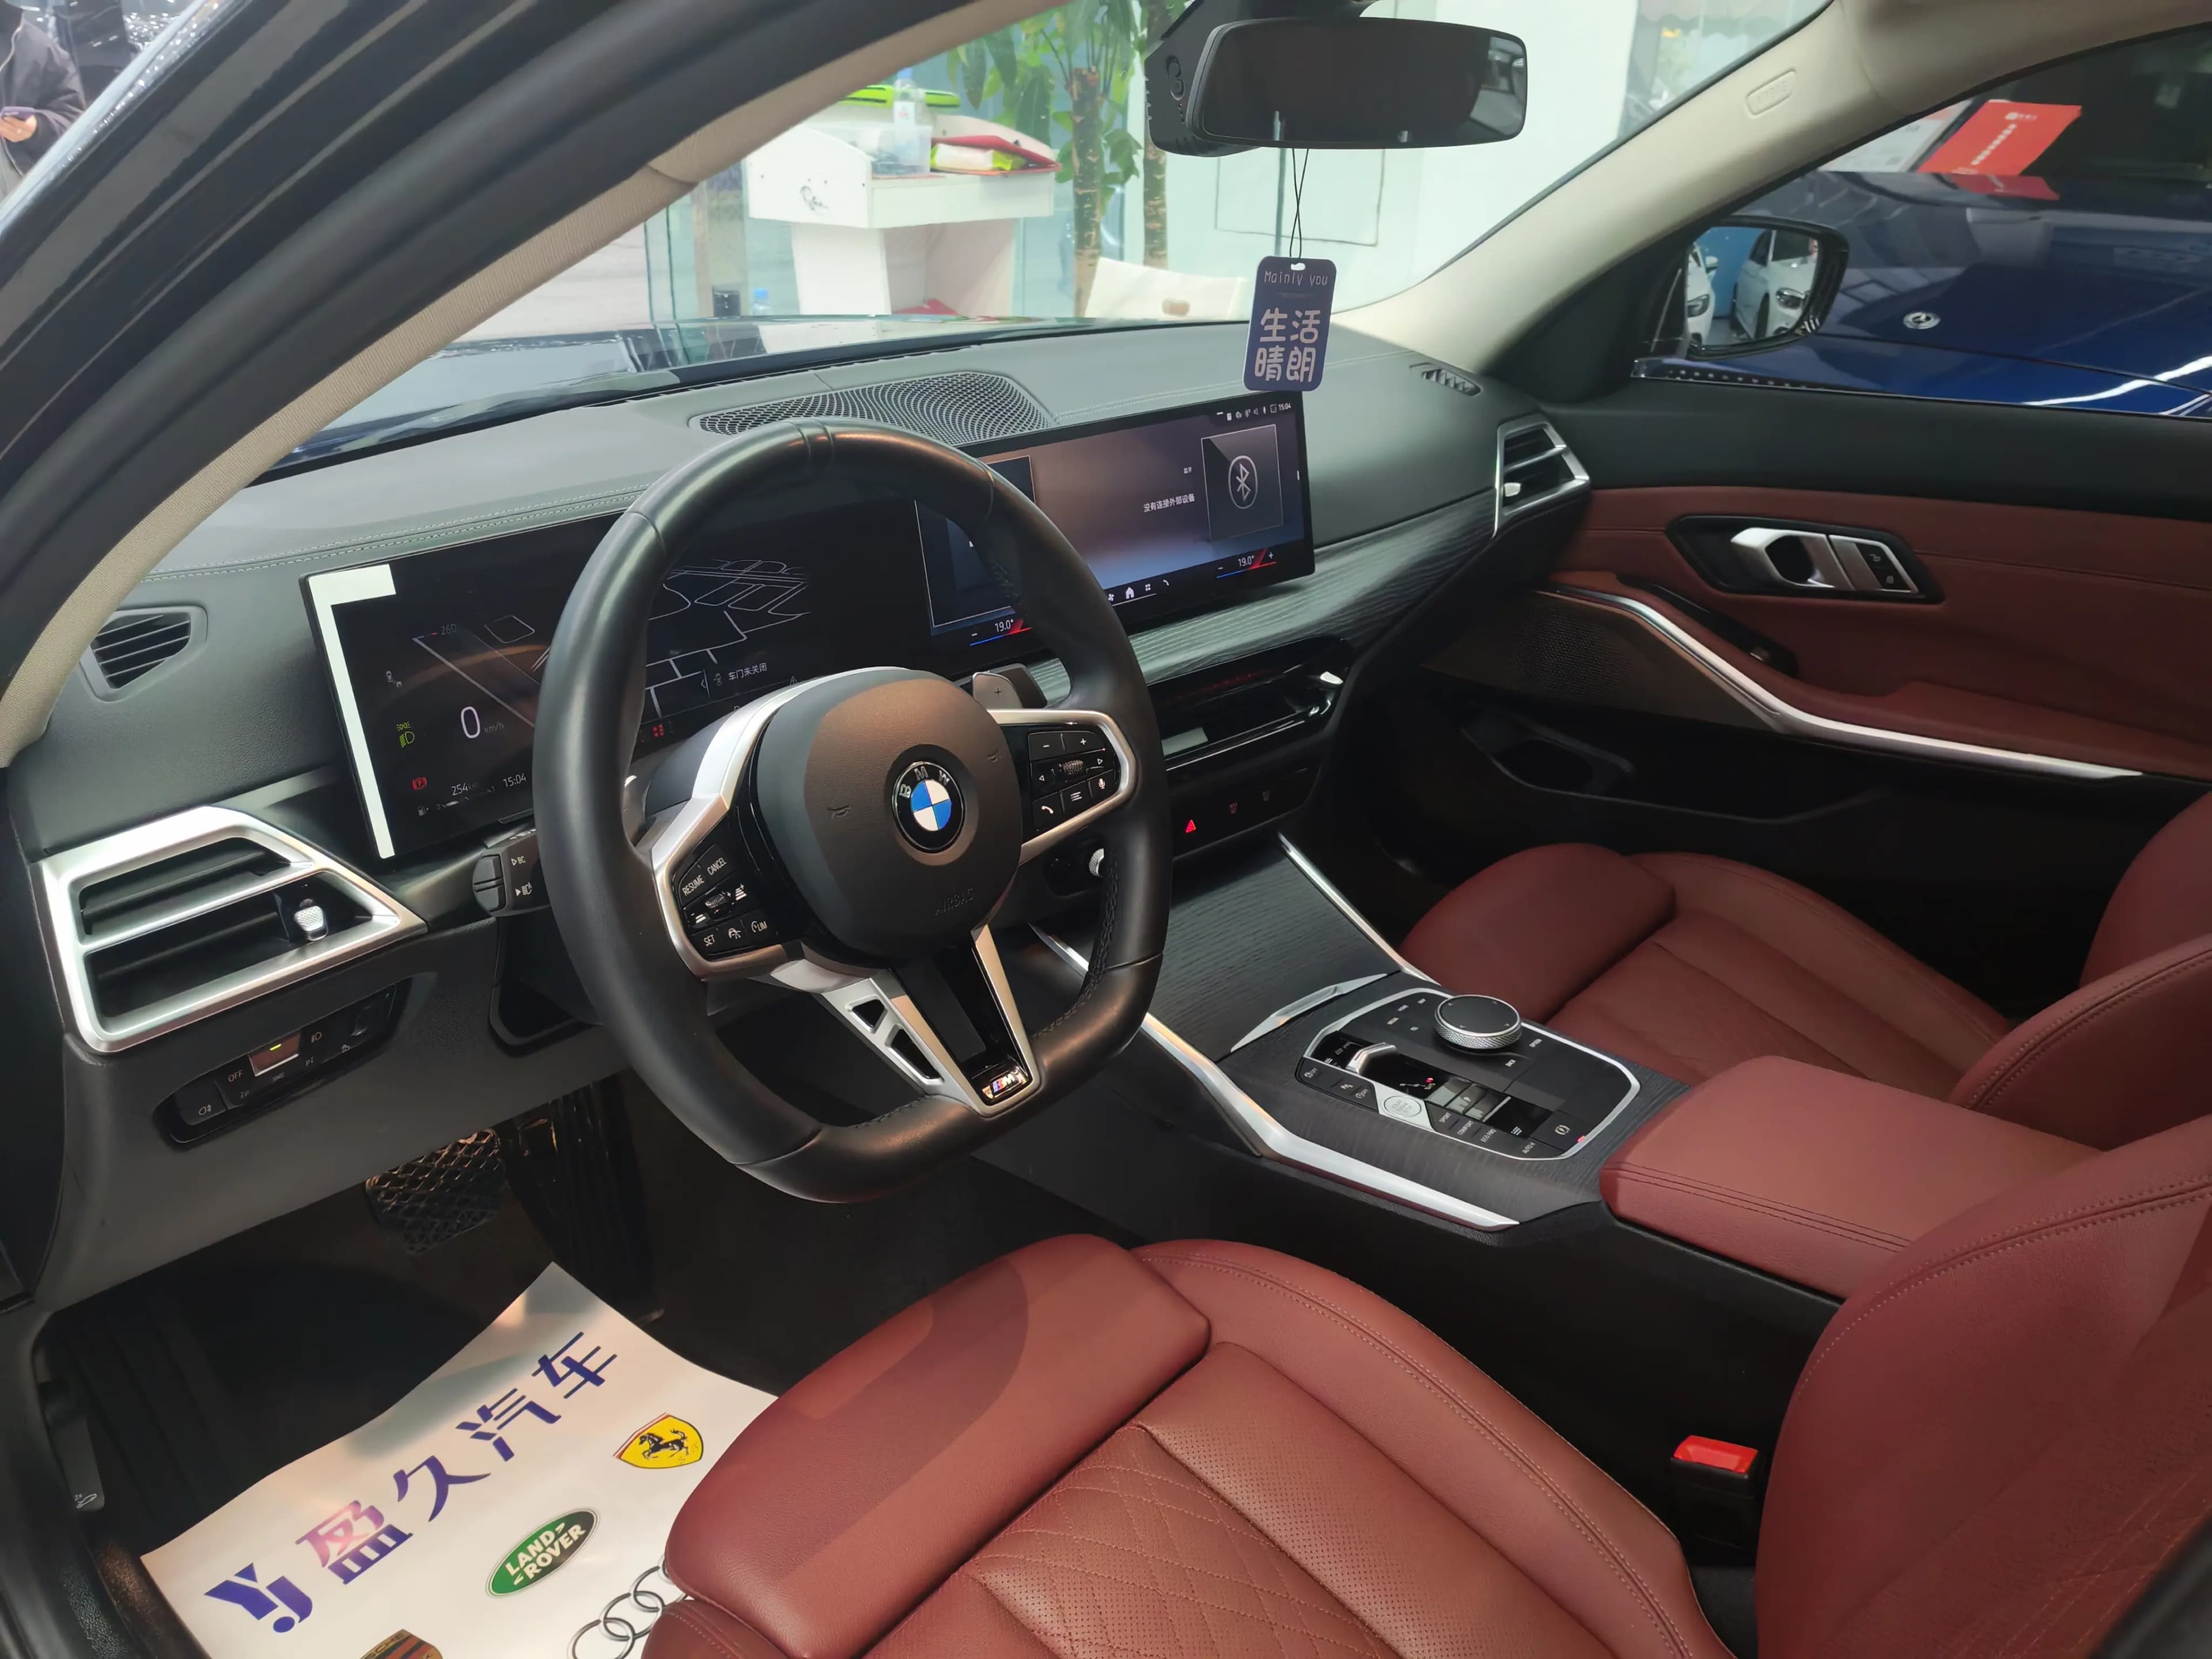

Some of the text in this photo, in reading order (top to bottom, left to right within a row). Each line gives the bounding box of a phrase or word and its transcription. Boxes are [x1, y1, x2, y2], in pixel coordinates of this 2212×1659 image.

[1260, 308, 1321, 344] 生活
[1254, 345, 1316, 382] 晴朗
[1143, 493, 1195, 513] 没有连接外部设备
[728, 662, 768, 681] 车门未关闭
[461, 706, 505, 738] 0 km/h
[451, 782, 469, 796] 254
[503, 772, 527, 788] 15:04
[899, 766, 950, 799] BMW
[517, 856, 525, 864] BC
[707, 857, 727, 876] CANCEL
[682, 874, 704, 896] RESUME
[757, 921, 767, 931] LIM
[703, 934, 715, 947] SET
[229, 1070, 244, 1082] OFF
[295, 1331, 618, 1585] 盈久汽车
[505, 1531, 555, 1576] LAND
[523, 1524, 586, 1580] ROVER
